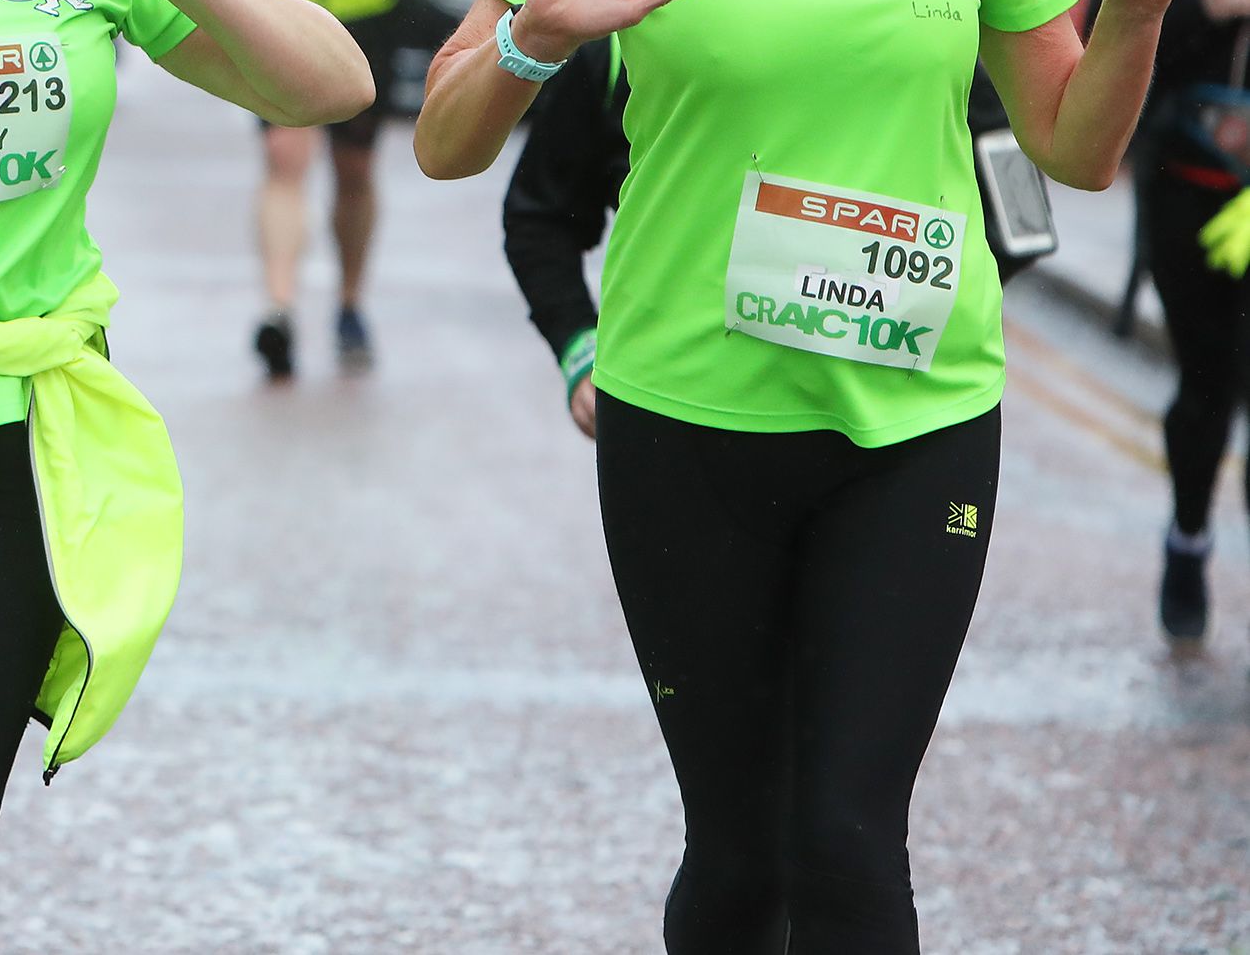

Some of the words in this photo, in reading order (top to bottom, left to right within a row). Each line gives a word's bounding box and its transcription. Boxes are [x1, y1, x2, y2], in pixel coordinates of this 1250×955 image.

[912, 1, 962, 21] Linda
[800, 196, 917, 237] SPAR
[862, 241, 954, 290] 1092
[801, 275, 885, 312] LINDA
